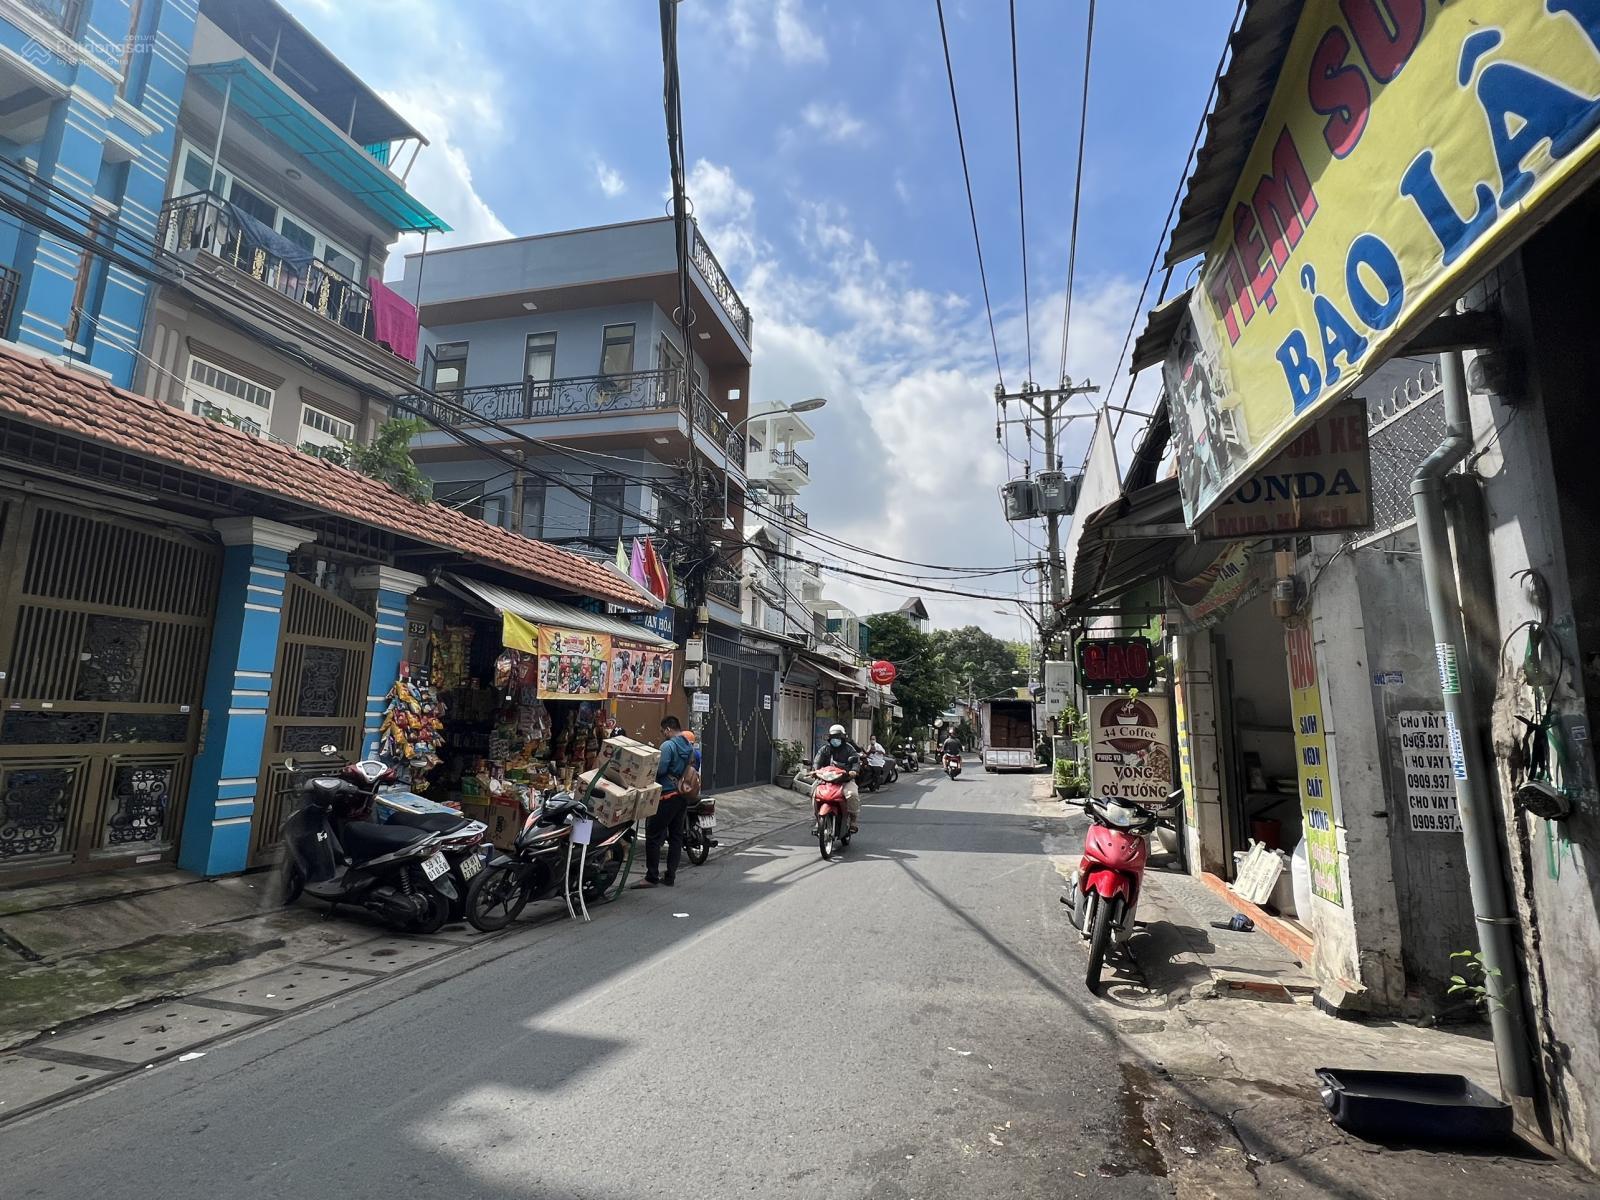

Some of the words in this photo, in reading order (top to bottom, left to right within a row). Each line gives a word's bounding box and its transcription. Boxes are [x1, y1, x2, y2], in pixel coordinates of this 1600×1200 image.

[1275, 232, 1404, 417] BẢO
[1399, 0, 1600, 267] LÂ
[1224, 468, 1361, 504] ONDA
[1103, 728, 1116, 738] 44
[1119, 726, 1157, 739] Coffee
[1113, 763, 1154, 779] VÕNG
[1101, 781, 1119, 797] CỜ
[1121, 782, 1168, 798] TƯỚNG
[1409, 795, 1429, 809] CHO
[1431, 796, 1449, 810] VAY
